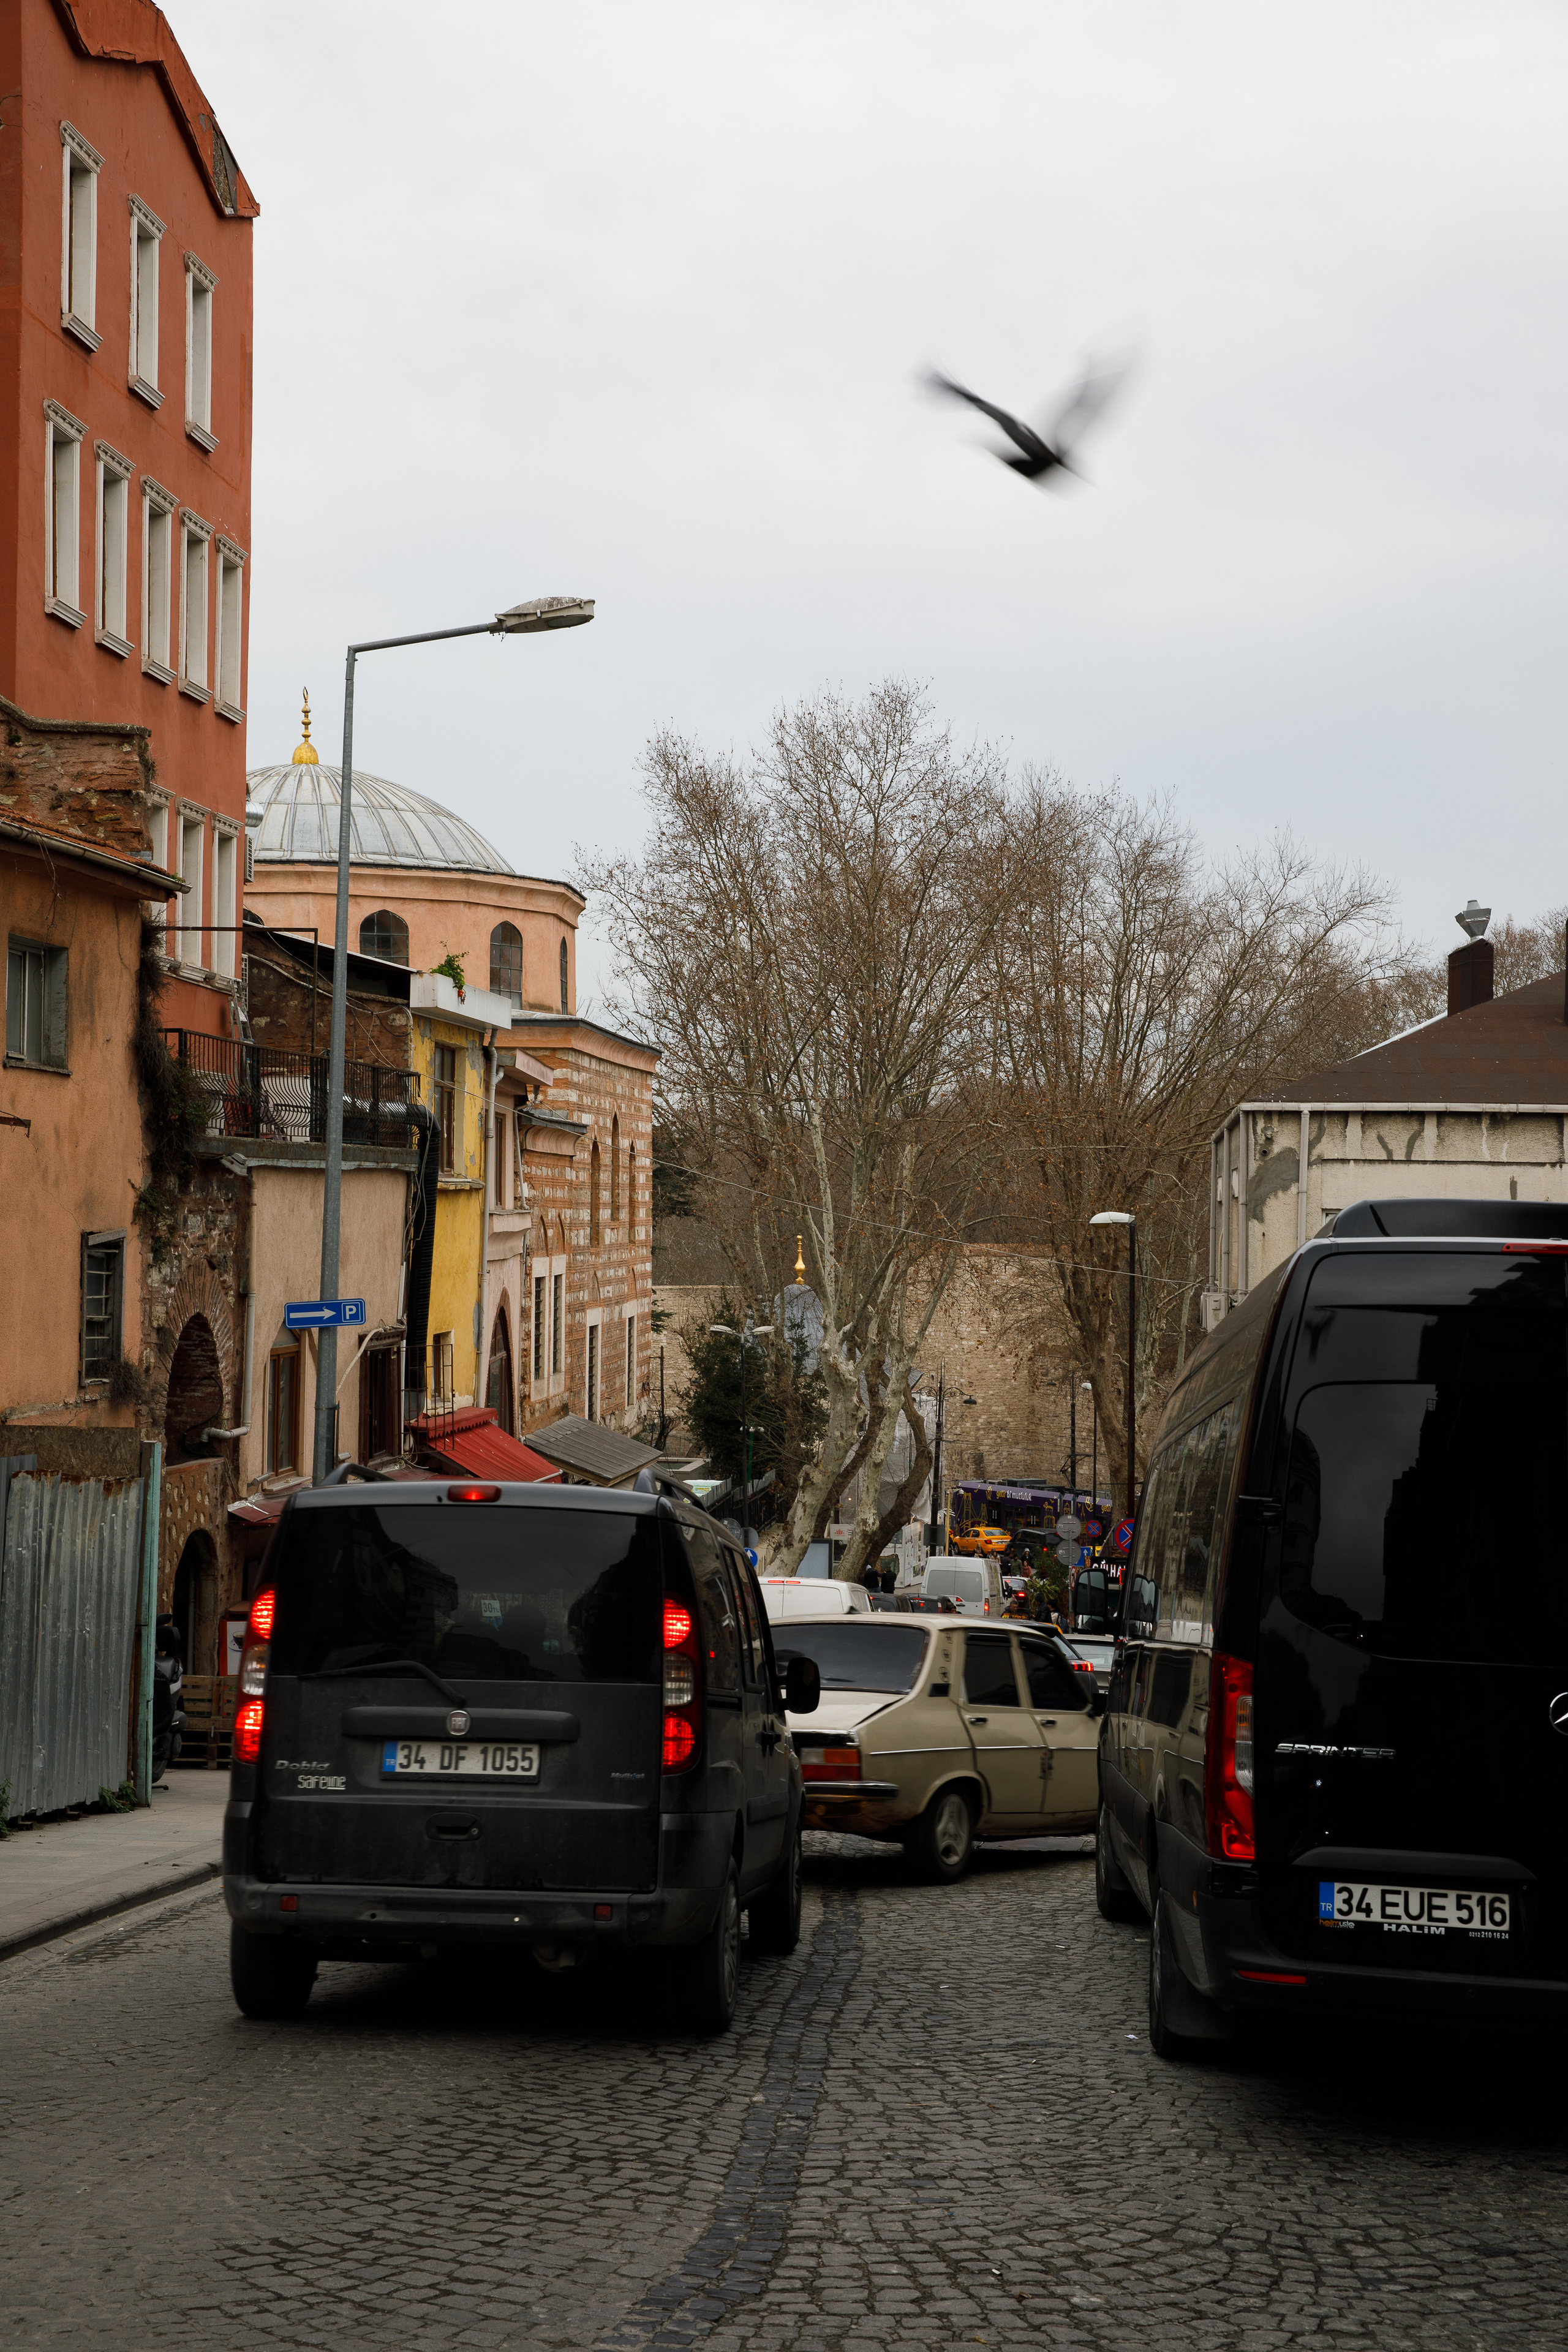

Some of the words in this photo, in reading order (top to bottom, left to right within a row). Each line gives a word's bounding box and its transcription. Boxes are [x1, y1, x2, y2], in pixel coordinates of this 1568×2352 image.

[345, 1305, 356, 1319] P
[451, 1717, 467, 1729] FIAT
[399, 1744, 426, 1770] 34
[439, 1746, 468, 1770] DF
[480, 1746, 533, 1772] 1055
[1275, 1743, 1396, 1759] SPRINTER
[1321, 1902, 1332, 1912] TR
[1336, 1886, 1373, 1918] 34
[1381, 1888, 1449, 1924] EUE
[1456, 1893, 1507, 1928] 516
